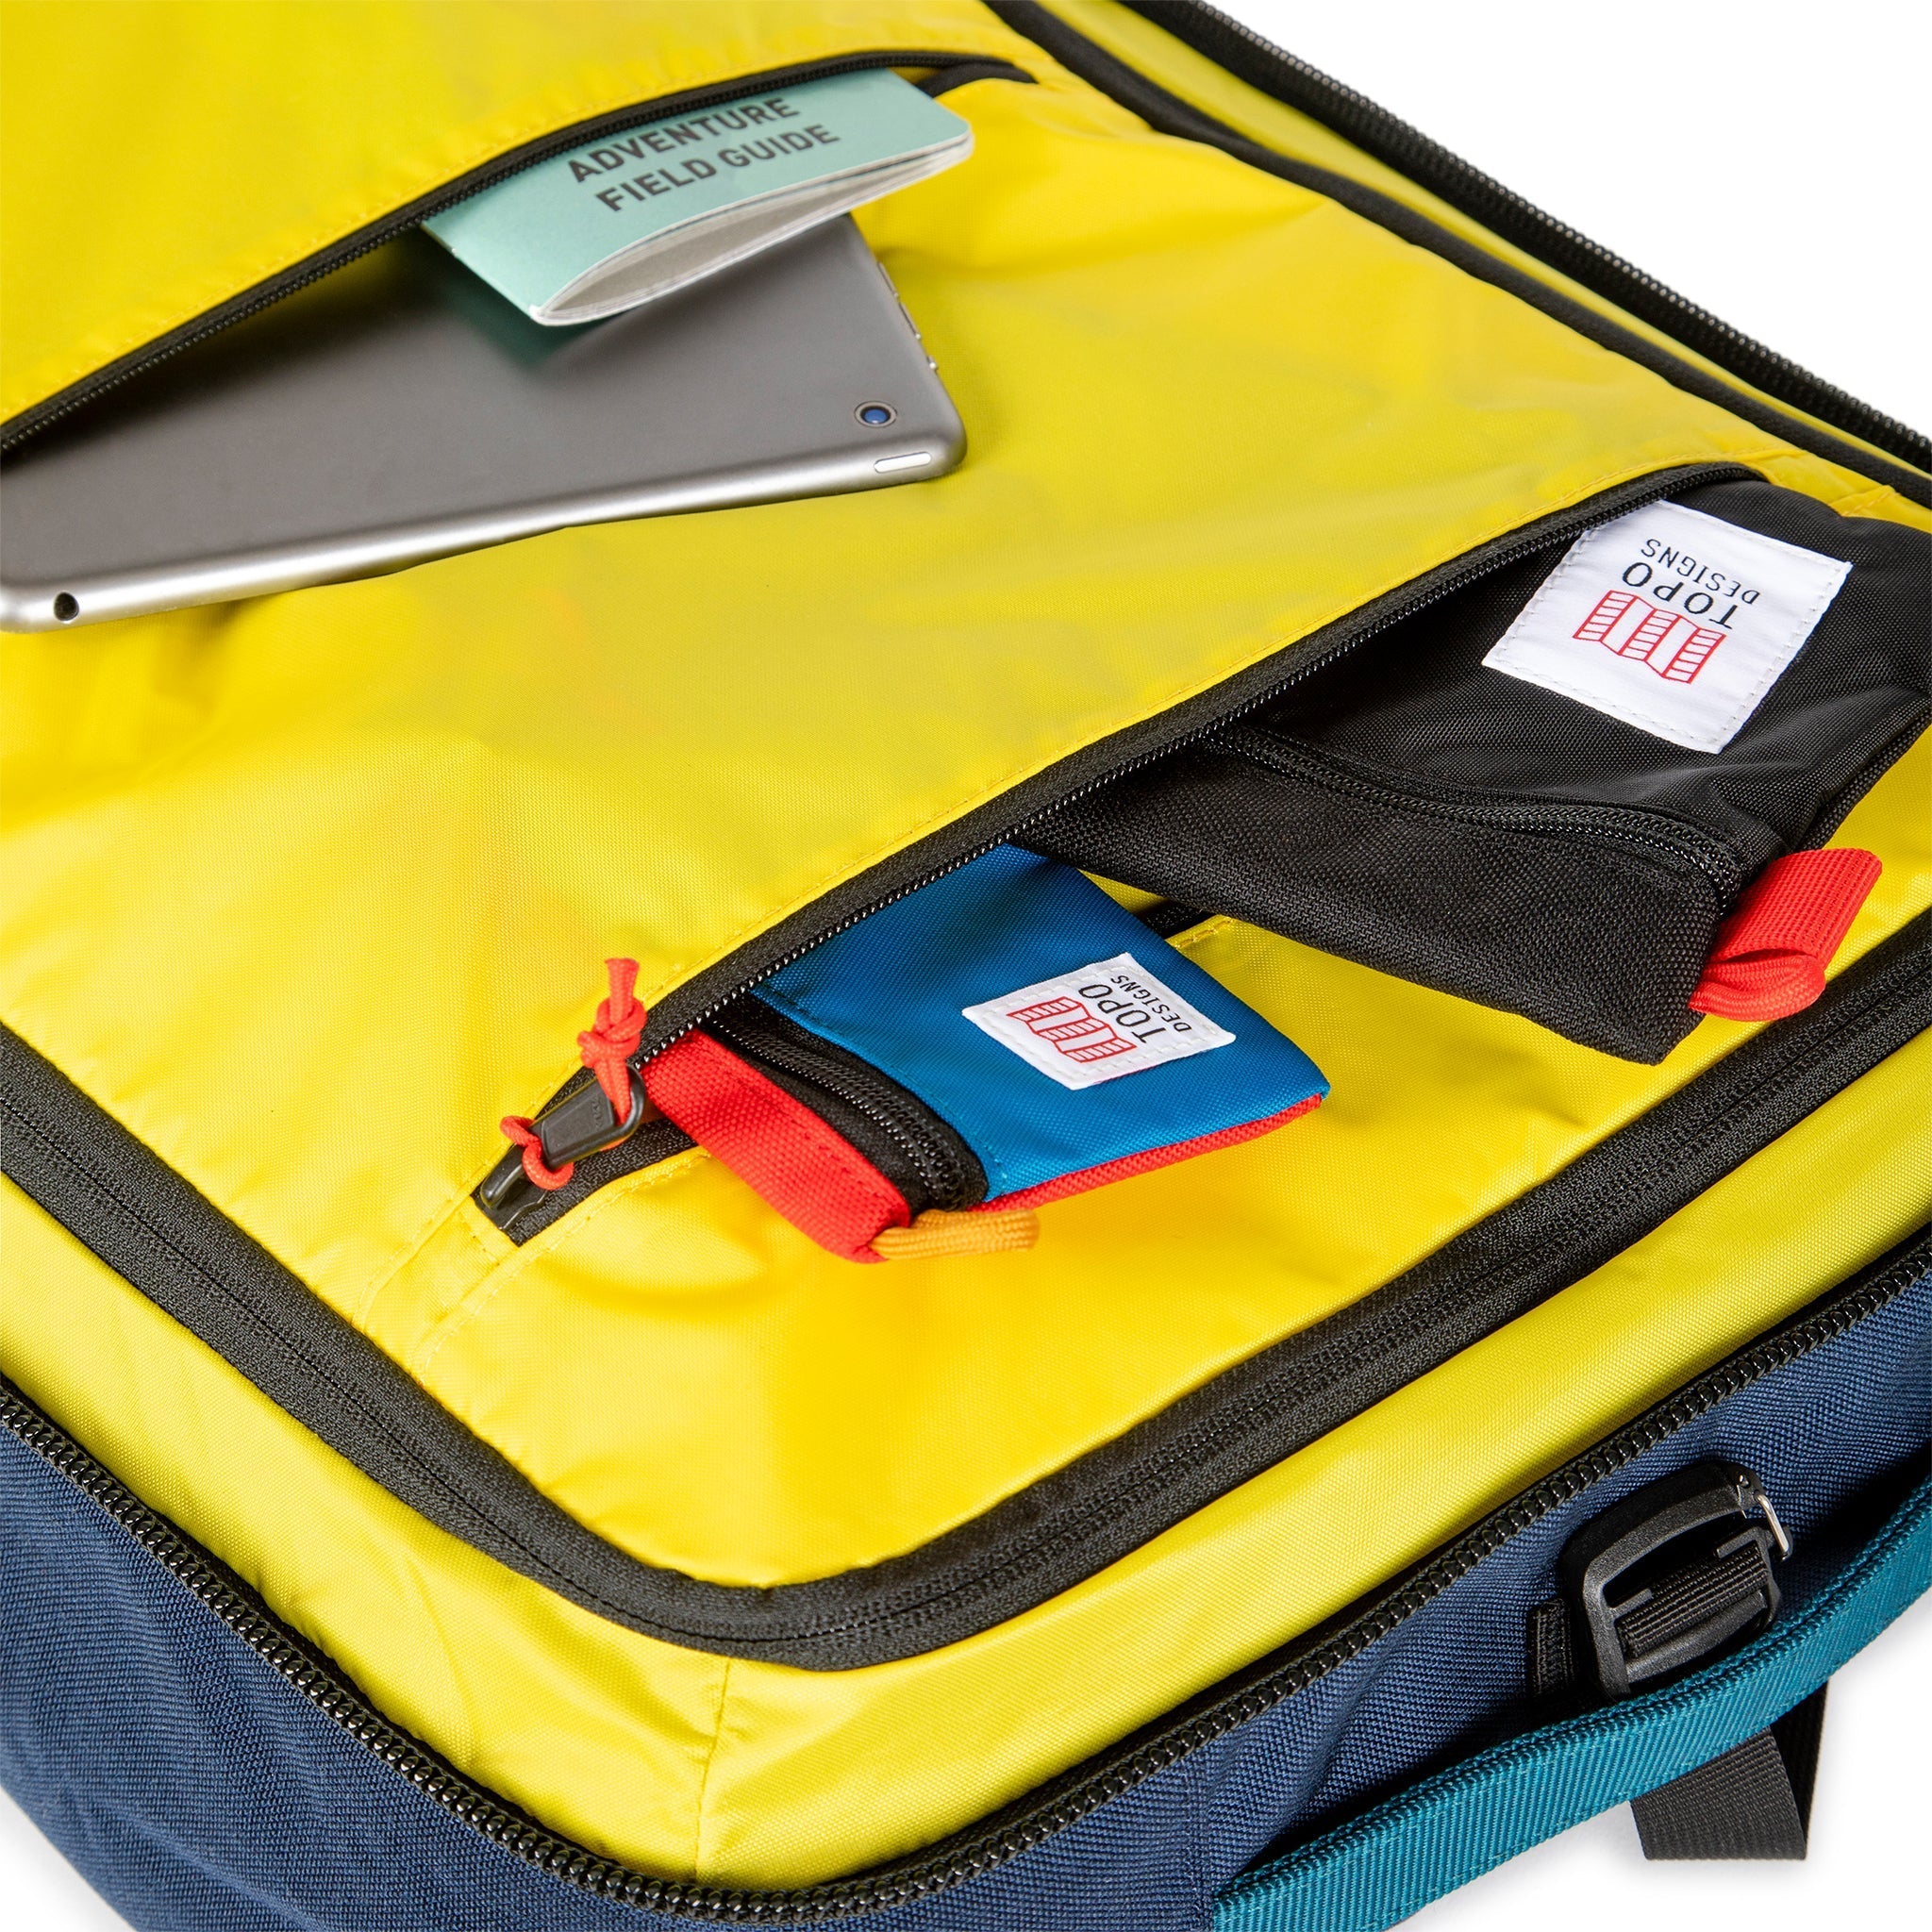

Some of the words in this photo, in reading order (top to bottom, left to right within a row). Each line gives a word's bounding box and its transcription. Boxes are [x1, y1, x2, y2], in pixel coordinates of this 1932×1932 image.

[568, 97, 800, 183] ADVENTURE
[596, 158, 717, 211] FIELD
[718, 124, 840, 167] GUIDE
[1622, 561, 1738, 629] TOPO
[1641, 538, 1760, 605] DESIGNS
[1077, 984, 1167, 1043] TOPO
[1110, 974, 1192, 1032] DESIGNS
